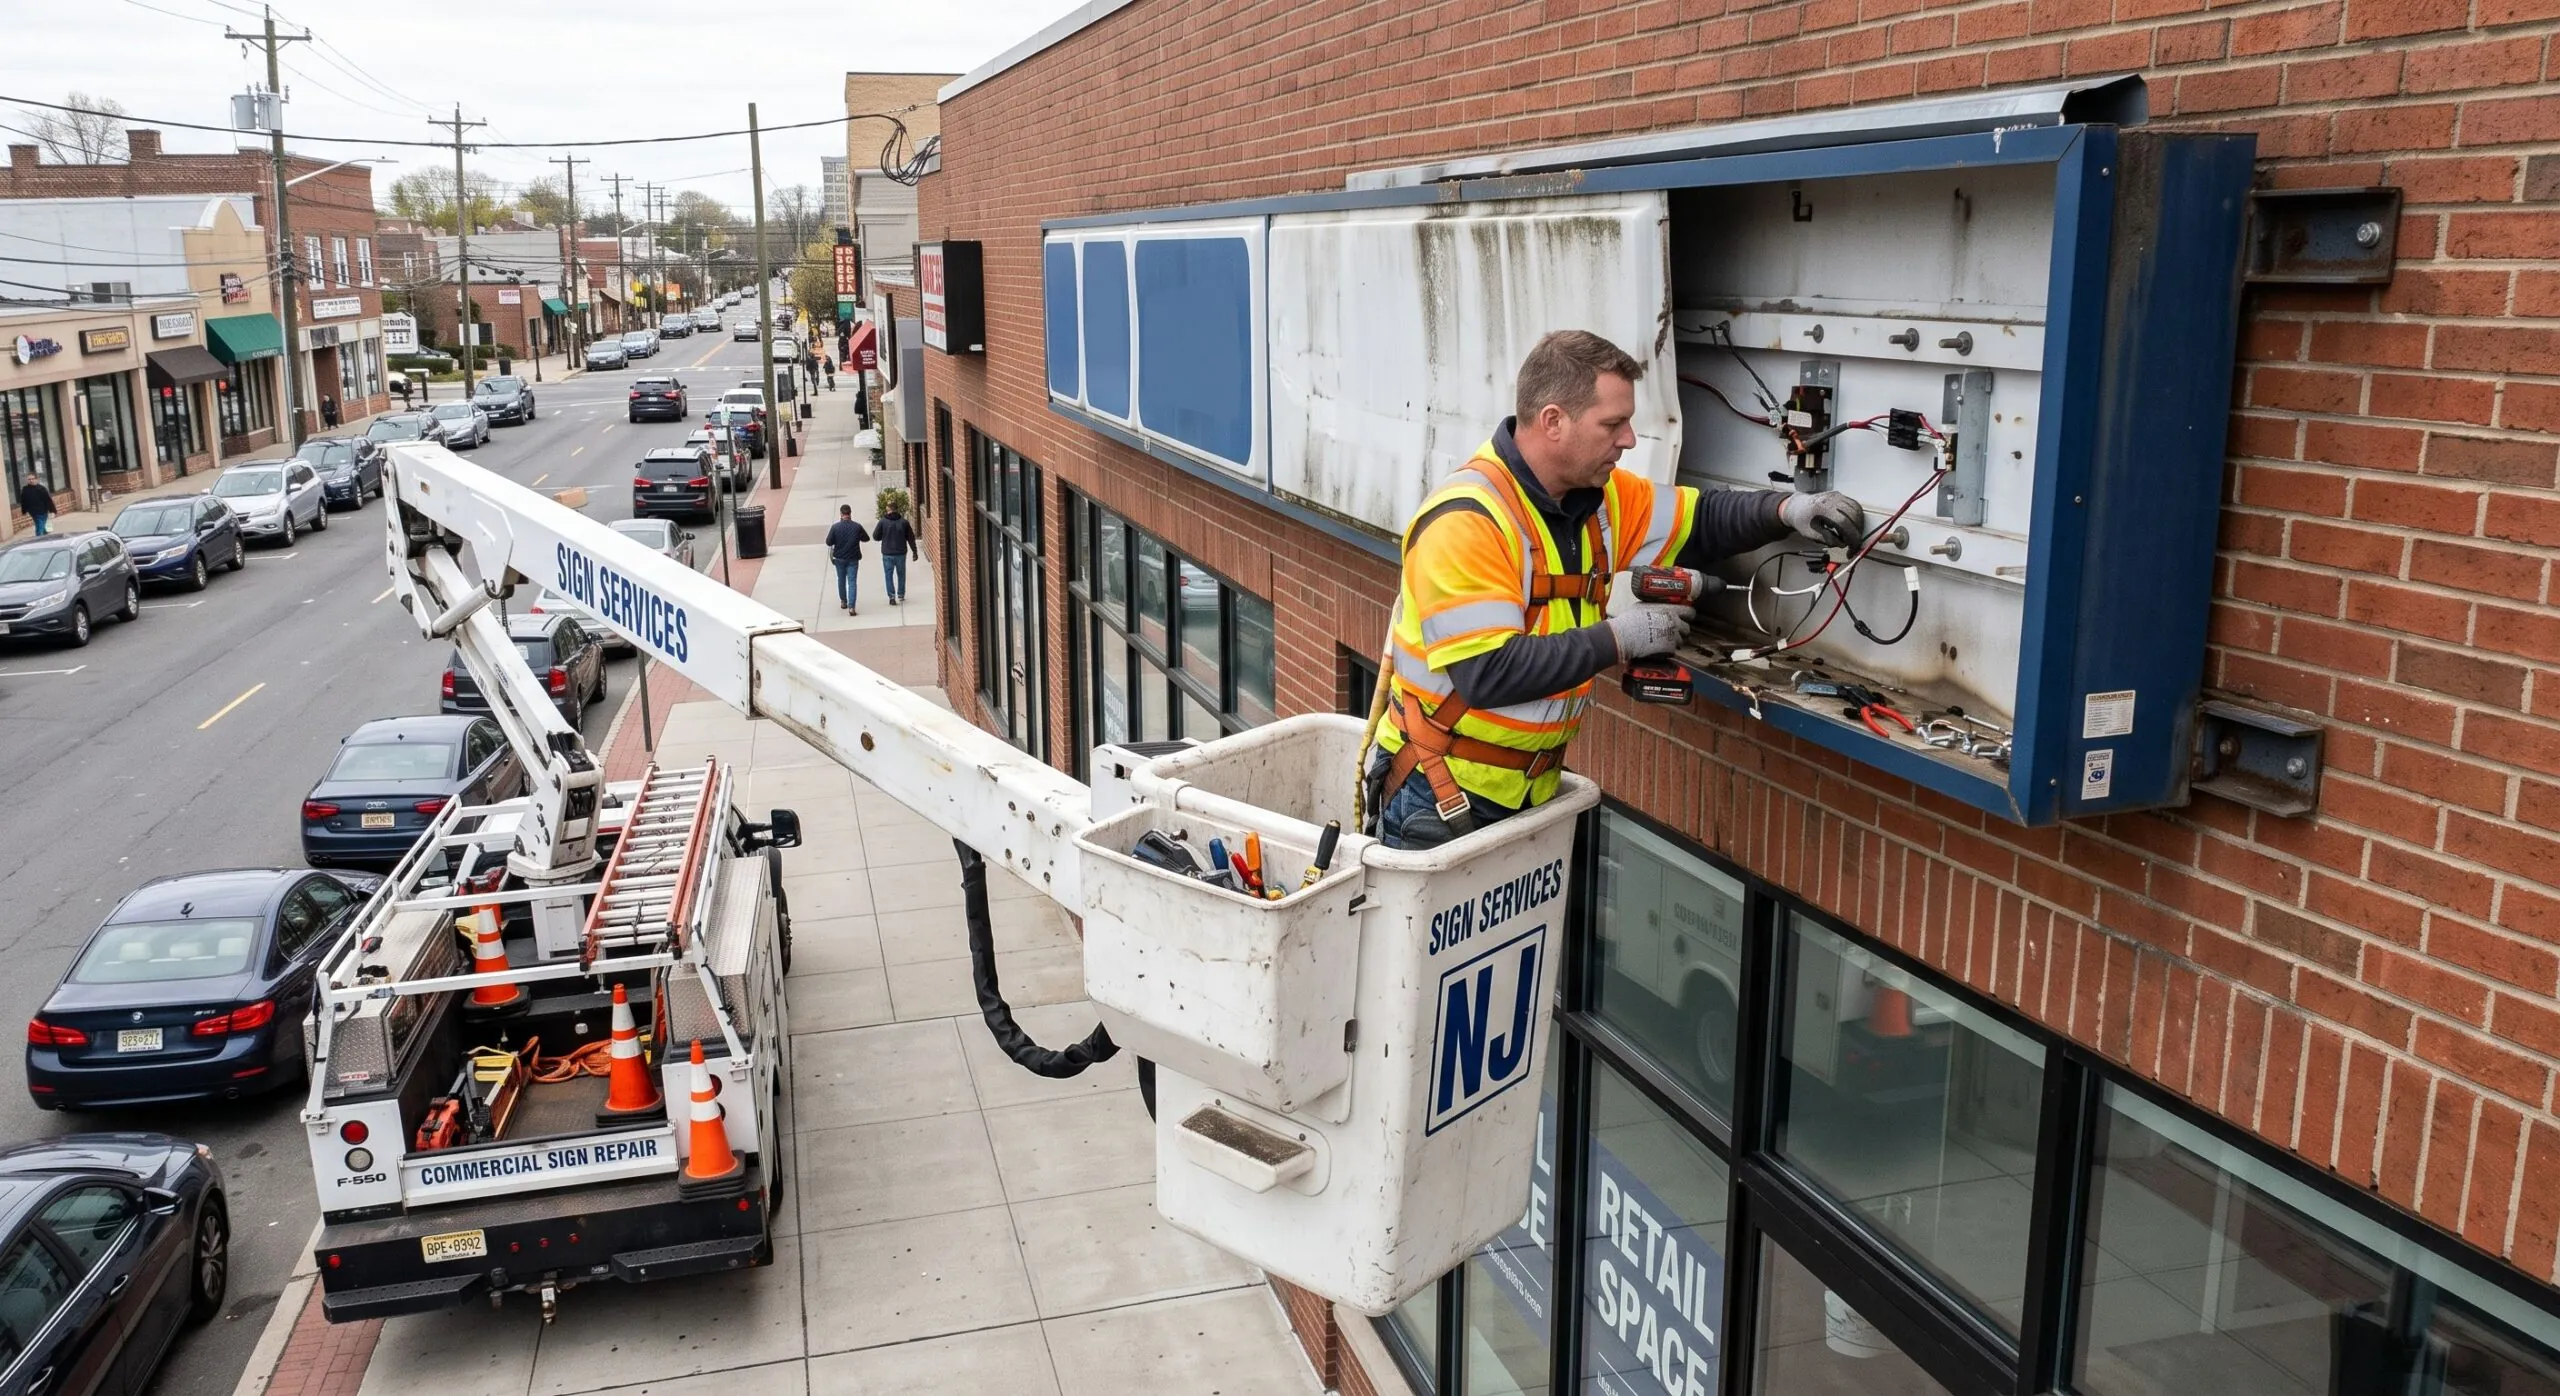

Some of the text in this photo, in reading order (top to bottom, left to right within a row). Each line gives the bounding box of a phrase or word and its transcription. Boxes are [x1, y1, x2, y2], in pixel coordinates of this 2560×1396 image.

[557, 542, 687, 663] SIGN SERVICES
[1428, 857, 1563, 957] SIGN SERVICES
[1436, 942, 1537, 1117] NJ
[336, 1172, 387, 1188] F-550
[421, 1139, 657, 1186] COMMERCIAL SIGN REPAIR
[1598, 1170, 1715, 1346] RETAIL
[1597, 1258, 1709, 1396] SPACE
